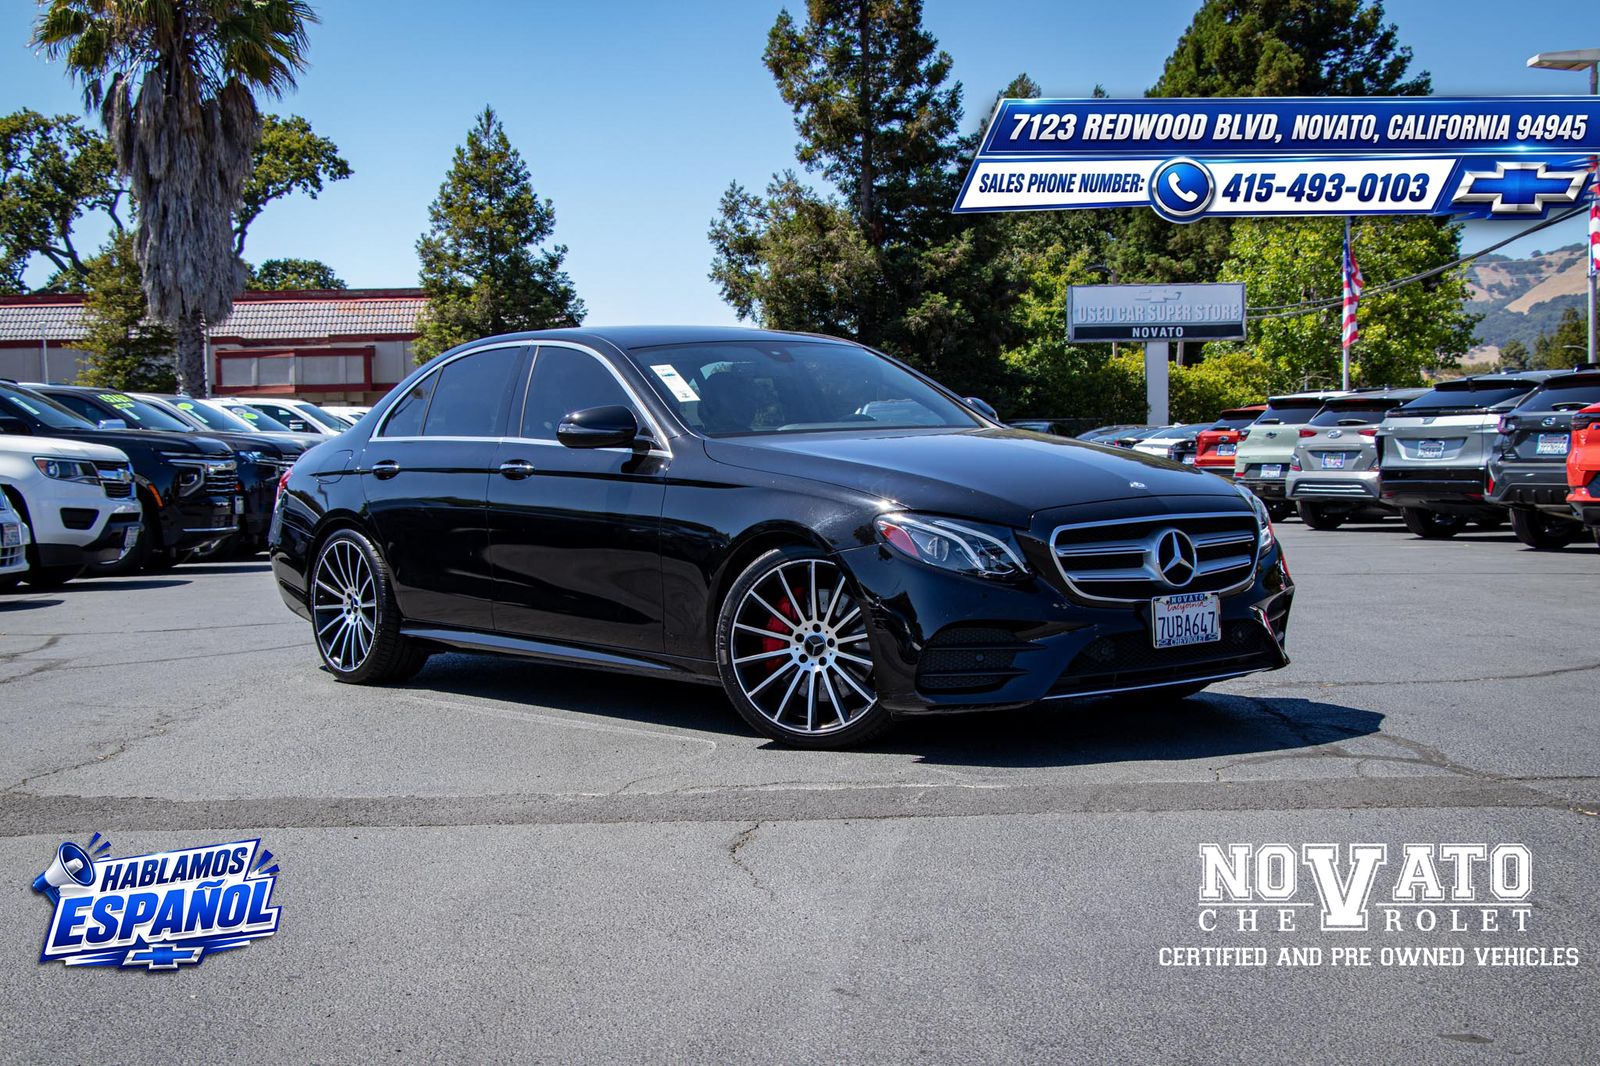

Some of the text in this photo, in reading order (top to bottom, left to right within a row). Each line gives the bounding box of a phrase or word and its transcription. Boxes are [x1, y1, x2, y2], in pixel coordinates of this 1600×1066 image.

[1080, 303, 1239, 322] USED CAR SUPER STORE
[1132, 326, 1184, 338] NOVATO
[1171, 594, 1204, 604] NOVATO
[1158, 611, 1215, 639] 7UBA647
